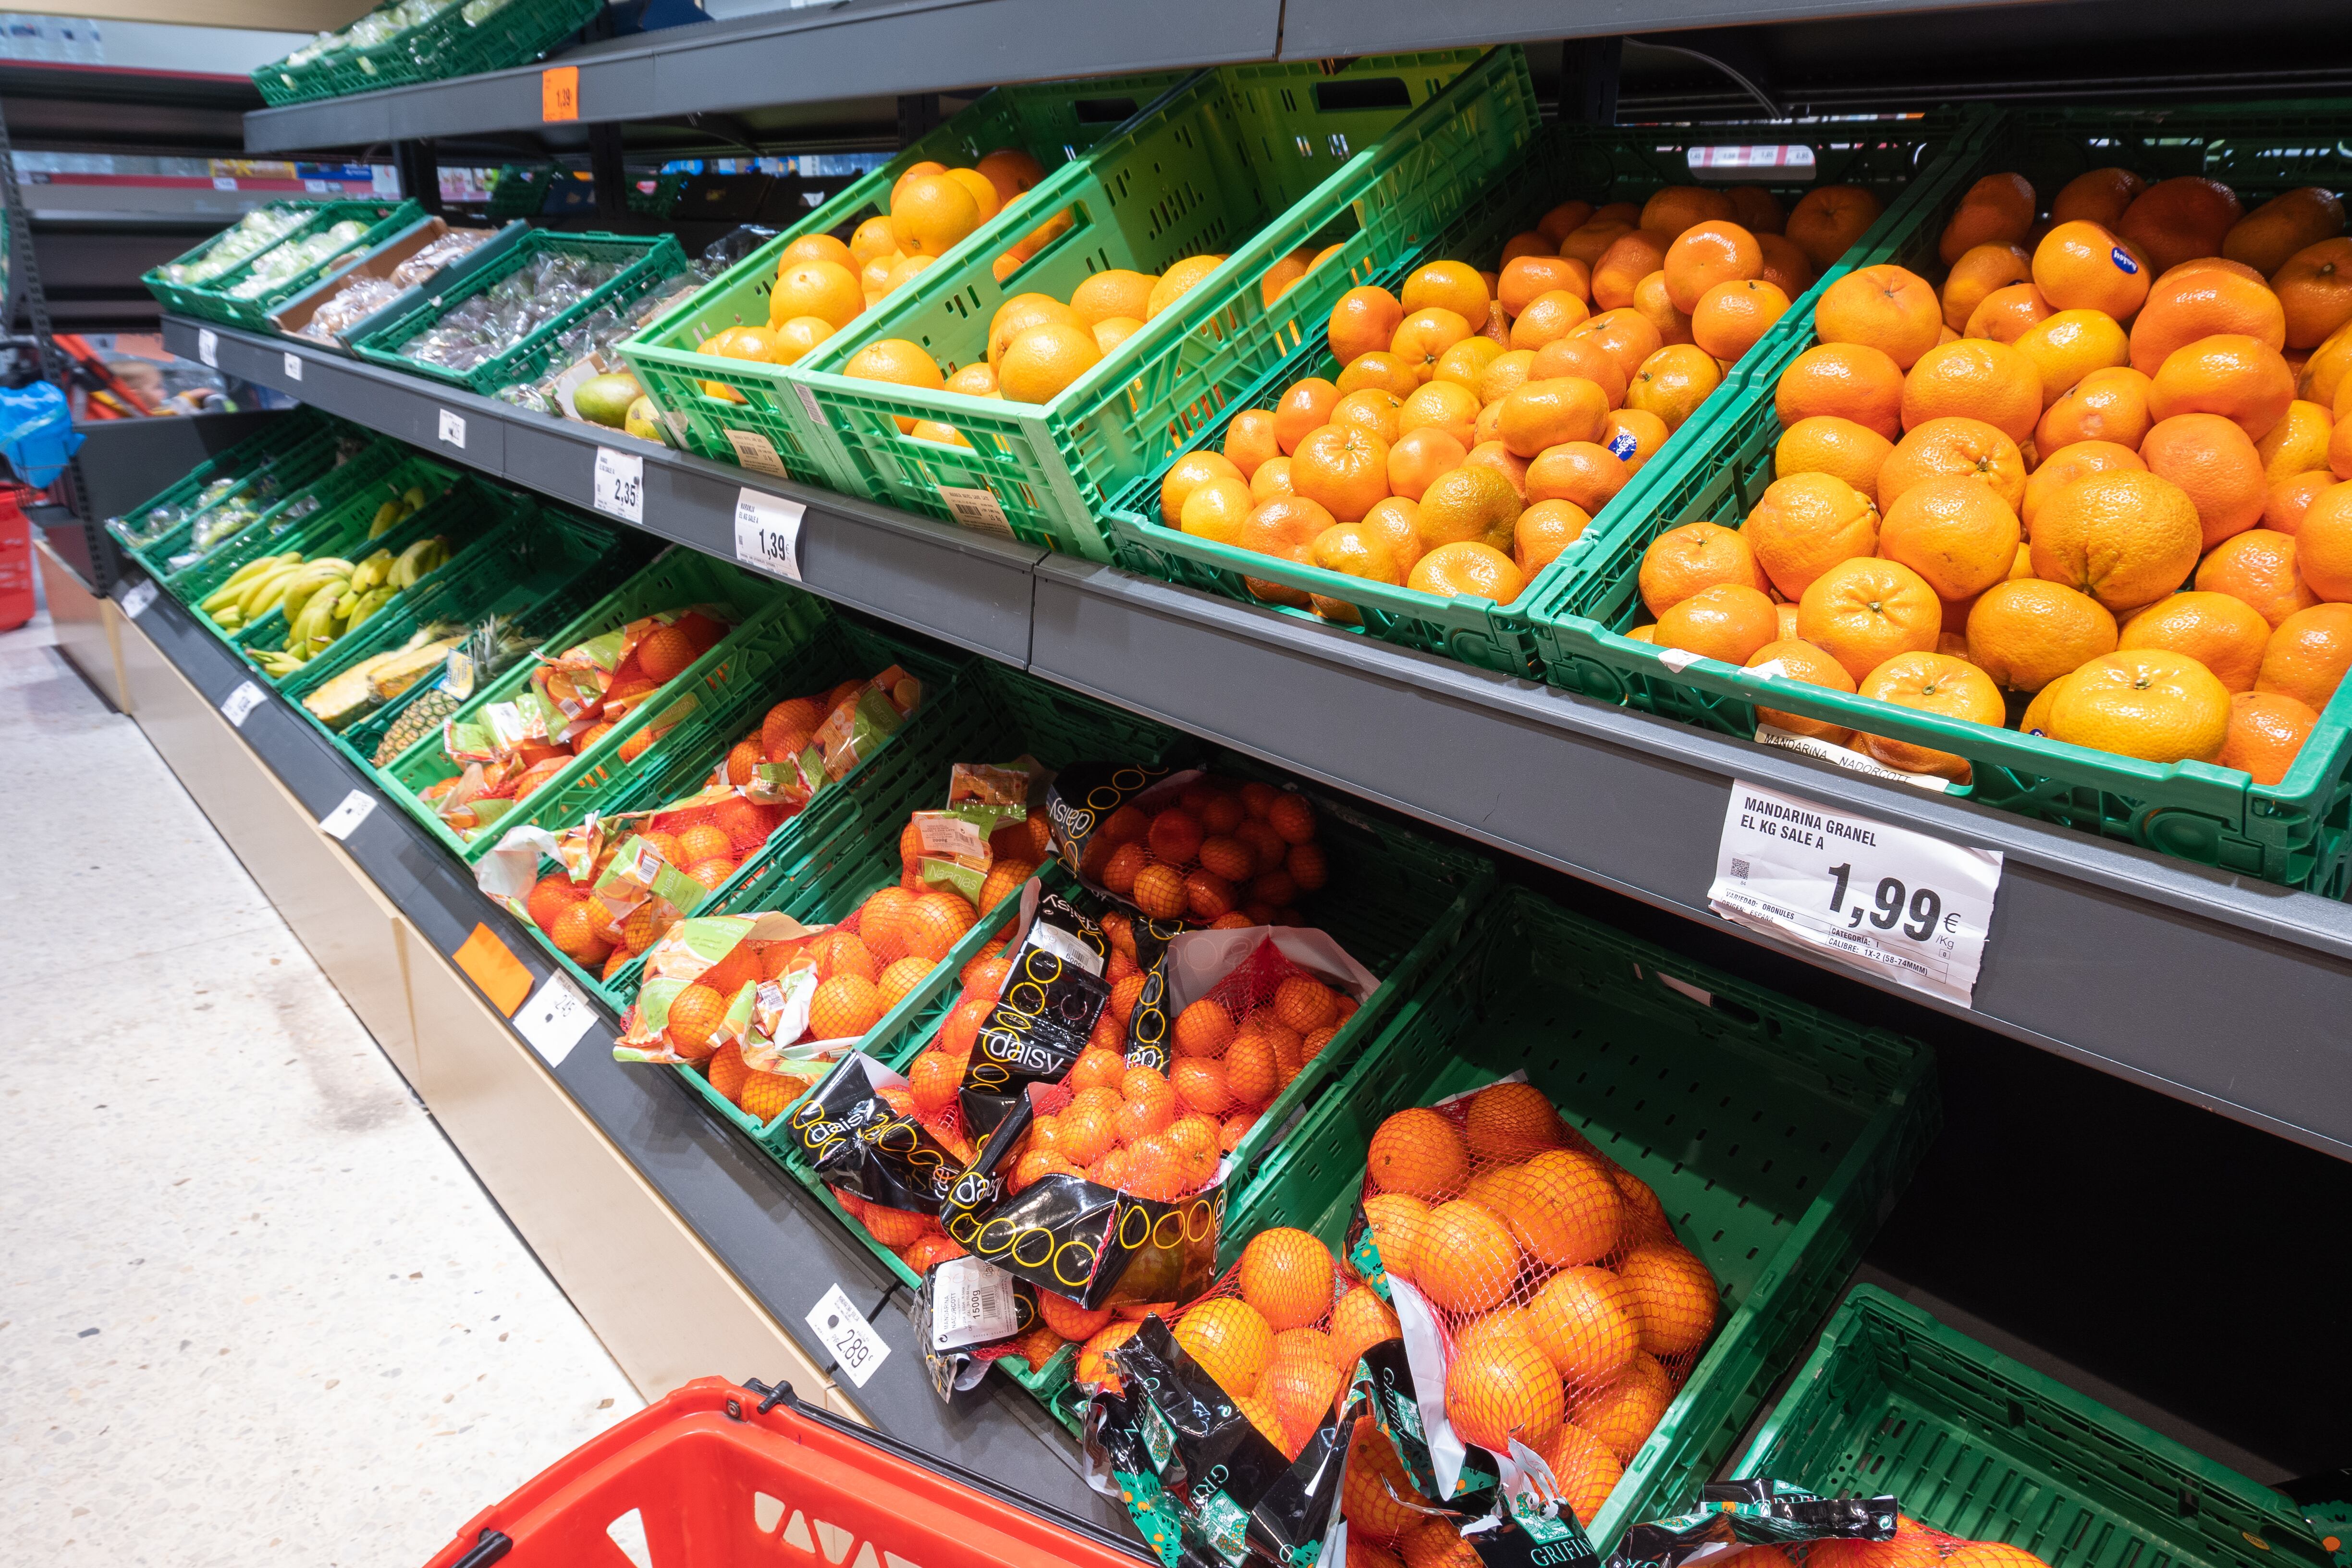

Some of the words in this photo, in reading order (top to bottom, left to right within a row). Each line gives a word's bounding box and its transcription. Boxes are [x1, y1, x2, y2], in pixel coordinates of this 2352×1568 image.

[614, 478, 636, 507] 2,35
[740, 503, 755, 513] NARANJA
[759, 528, 785, 561] 1,39
[1764, 733, 1827, 760] MANDARINA
[1839, 756, 1912, 784] NADORCOTT
[1050, 797, 1090, 834] daisy
[1744, 796, 1822, 830] MANDARINA
[1825, 820, 1876, 847] GRANEL
[1740, 814, 1755, 830] EL
[1759, 820, 1776, 836] KG
[1780, 825, 1813, 846] SALE
[1814, 836, 1825, 850] A
[929, 864, 978, 890] Naranjas
[1726, 891, 1758, 908] VARIEDAD:
[1762, 904, 1795, 920] ORONULES
[1828, 862, 1941, 942] 1,99
[1828, 938, 1859, 954] CALIBRE:
[1864, 949, 1880, 960] 1X-2
[1831, 928, 1871, 946] CATEGORÍA:
[990, 1032, 1065, 1075] daisy
[810, 1099, 874, 1143] daisy
[956, 1171, 1007, 1202] daisy
[971, 1289, 980, 1320] 1500g
